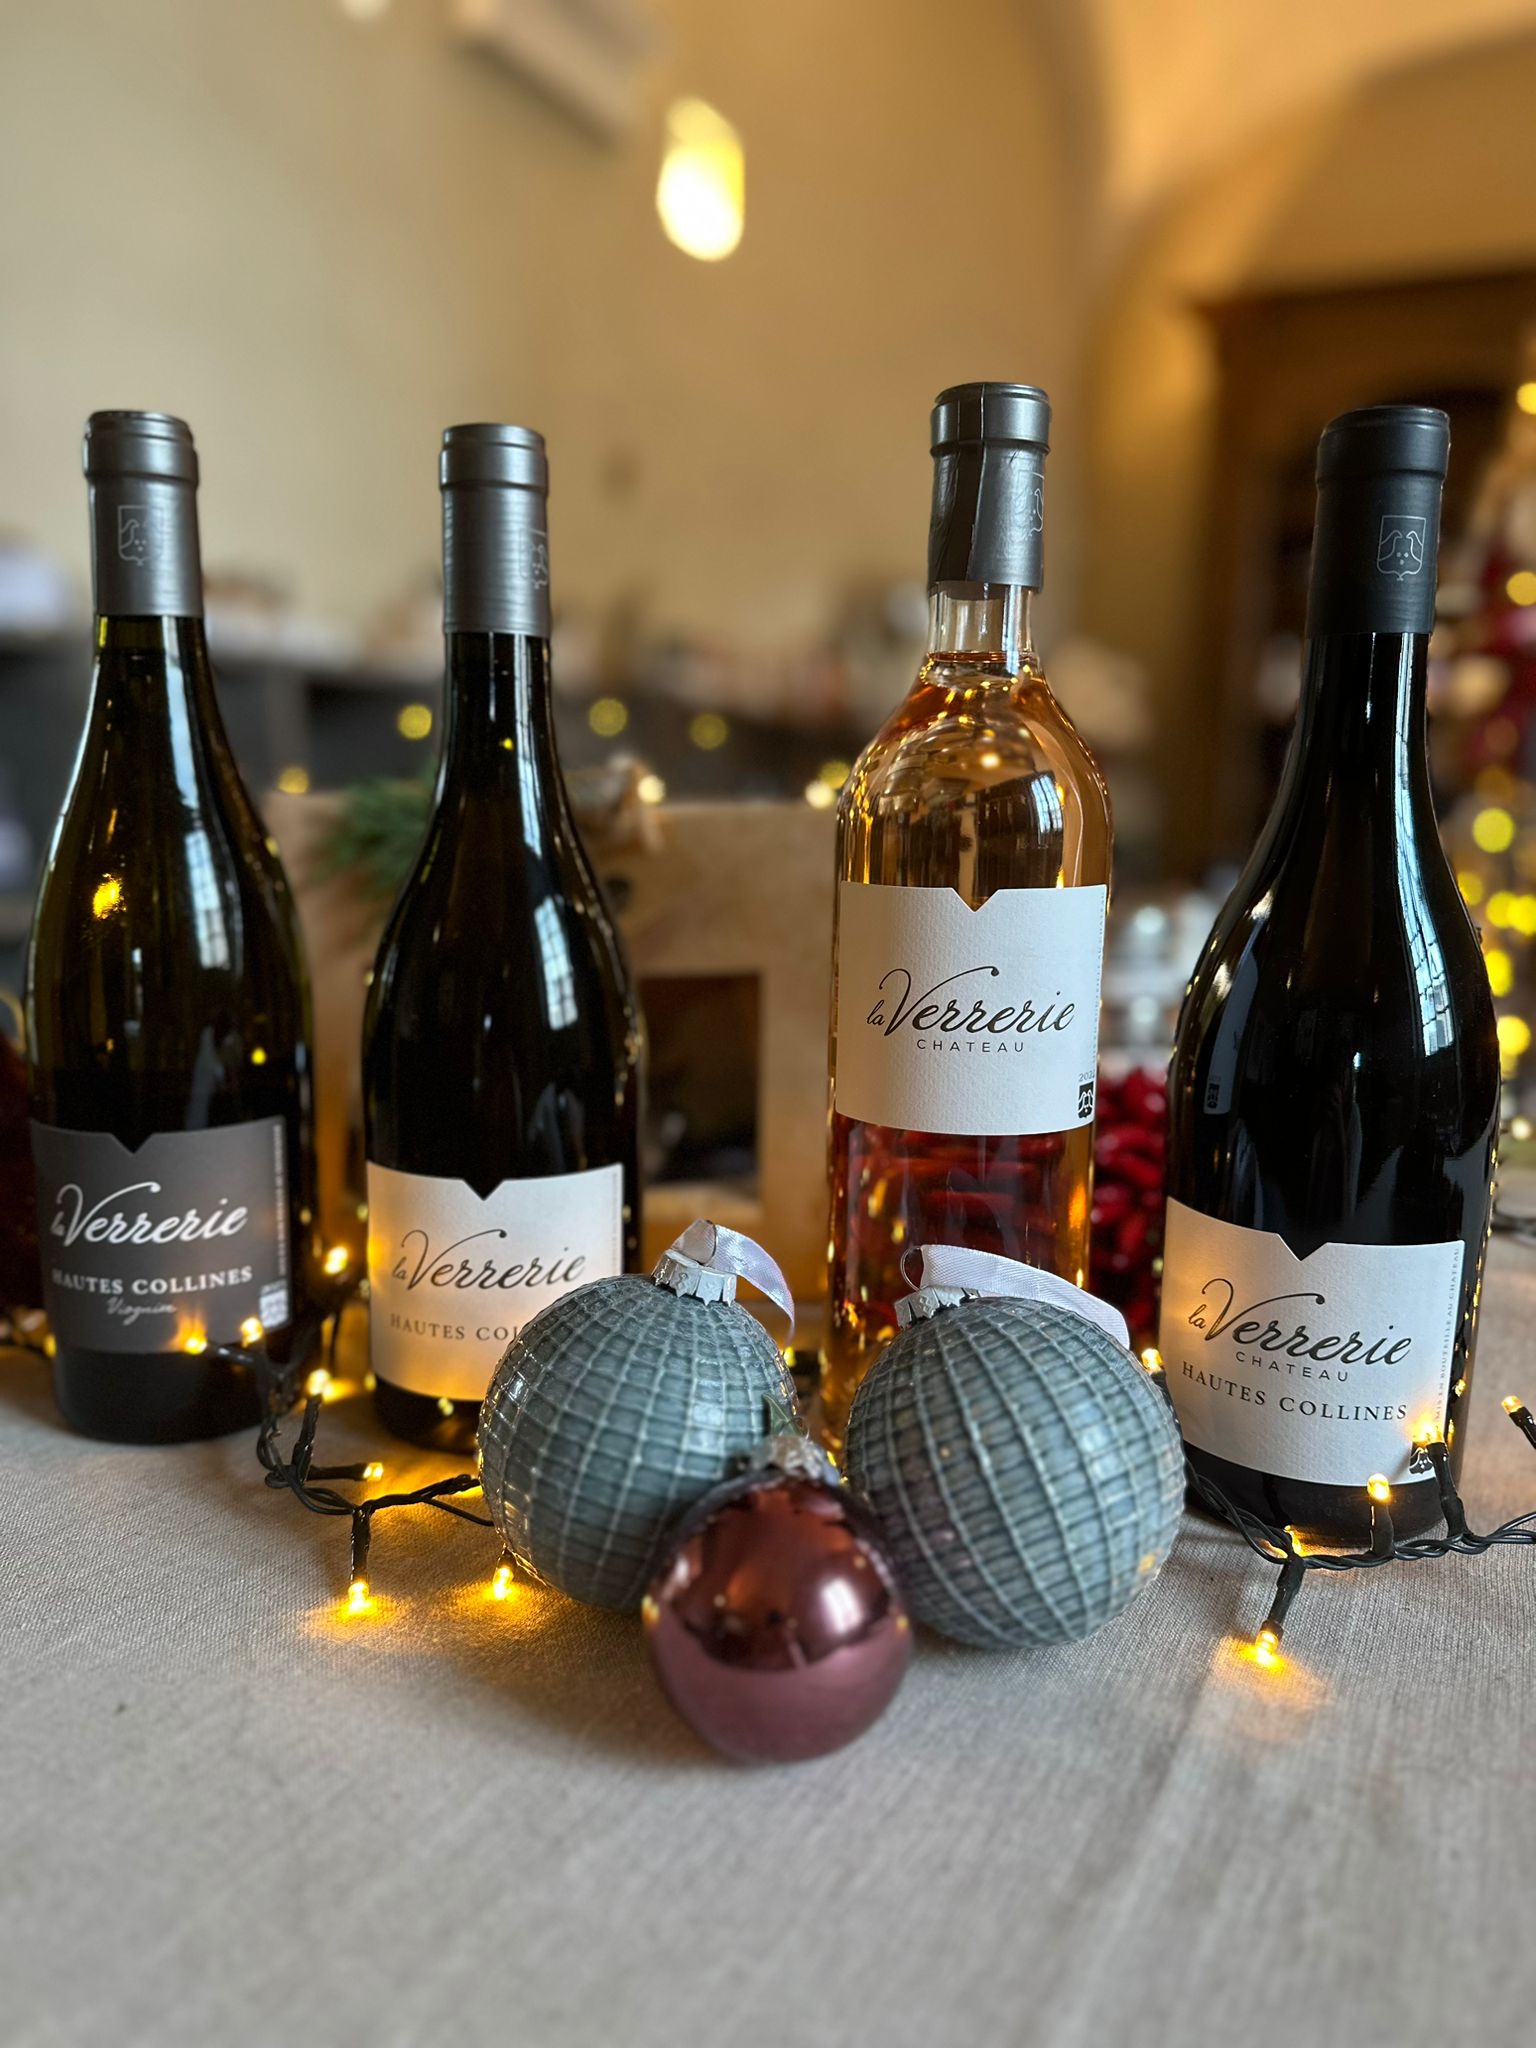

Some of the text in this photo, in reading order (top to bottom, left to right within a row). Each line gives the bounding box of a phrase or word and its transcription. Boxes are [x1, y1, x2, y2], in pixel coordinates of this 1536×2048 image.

[866, 965, 1075, 1037] la Verrerie
[916, 1038, 1024, 1053] CHATEAU
[57, 1181, 249, 1247] Verrerie
[52, 1268, 124, 1295] HAUTES
[132, 1266, 253, 1296] COLLINES
[392, 1228, 586, 1291] la Verrerie
[391, 1313, 465, 1340] HAUTES
[1188, 1278, 1412, 1366] la Verrerie
[1181, 1361, 1408, 1422] HAUTES COLLINES
[1235, 1351, 1350, 1383] CHATEAU
